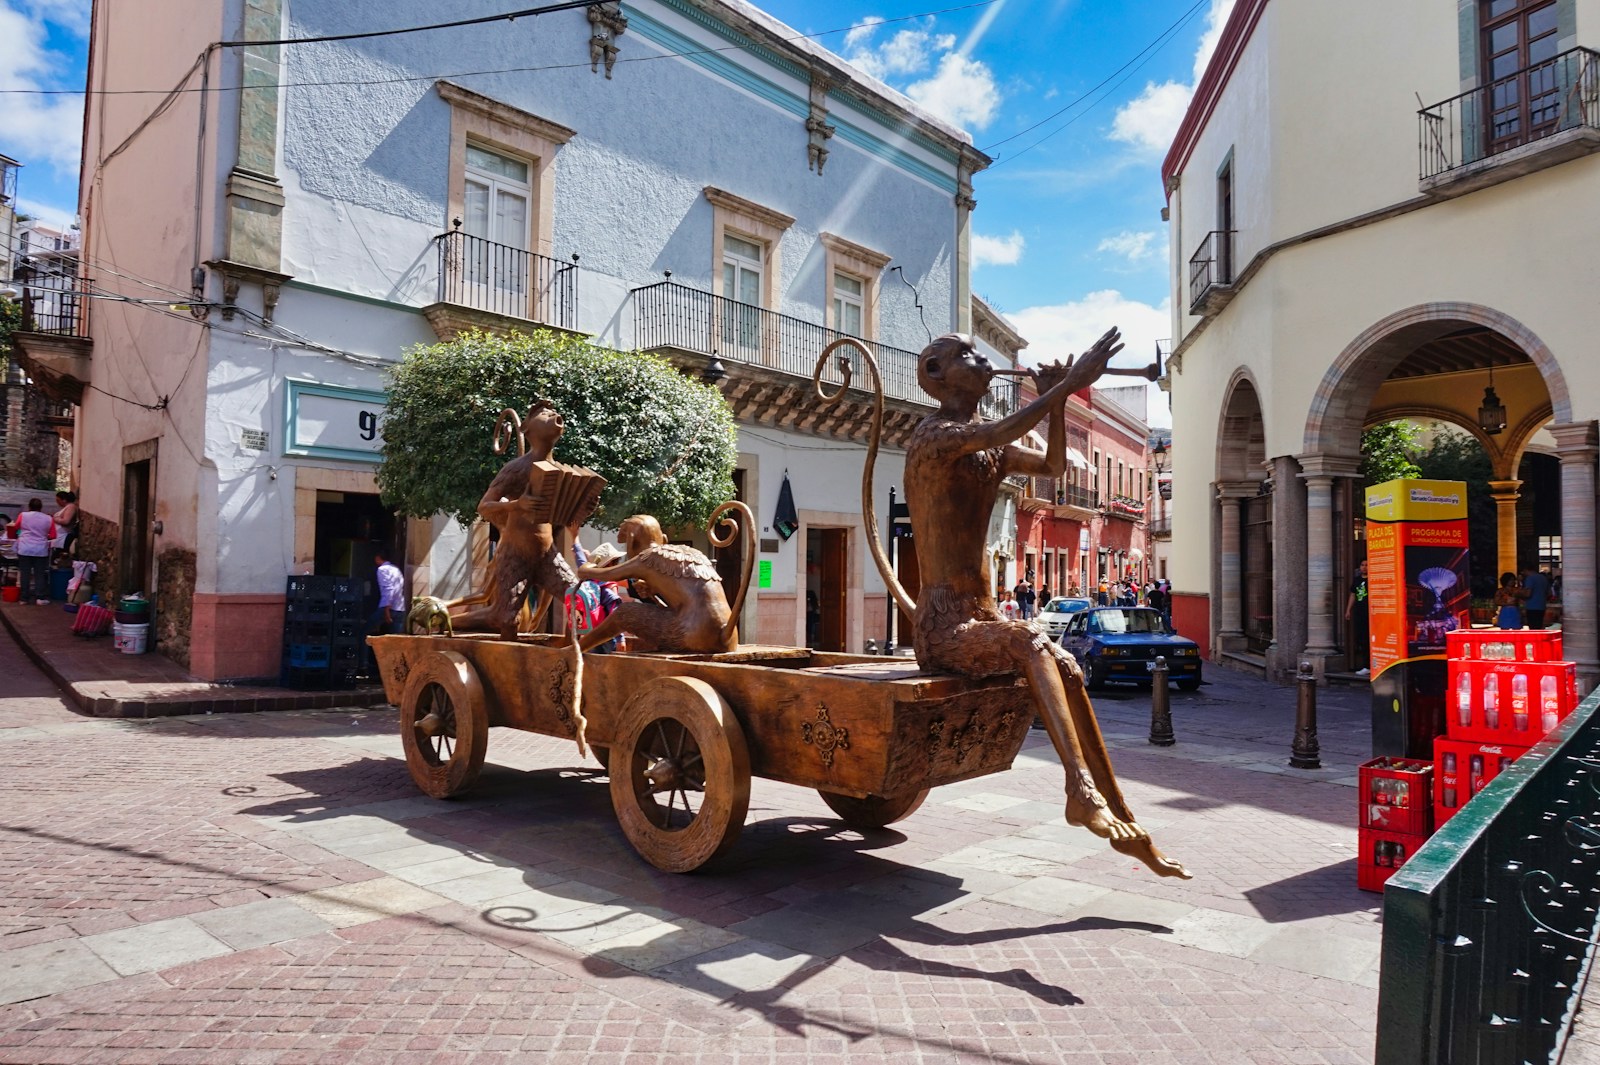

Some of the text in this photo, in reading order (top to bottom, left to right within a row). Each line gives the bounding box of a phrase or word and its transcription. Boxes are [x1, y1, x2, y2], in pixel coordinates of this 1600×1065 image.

[1368, 526, 1394, 538] PLAZA DEL
[1411, 528, 1451, 537] PROGRAMA
[1369, 538, 1395, 550] BARATILLO
